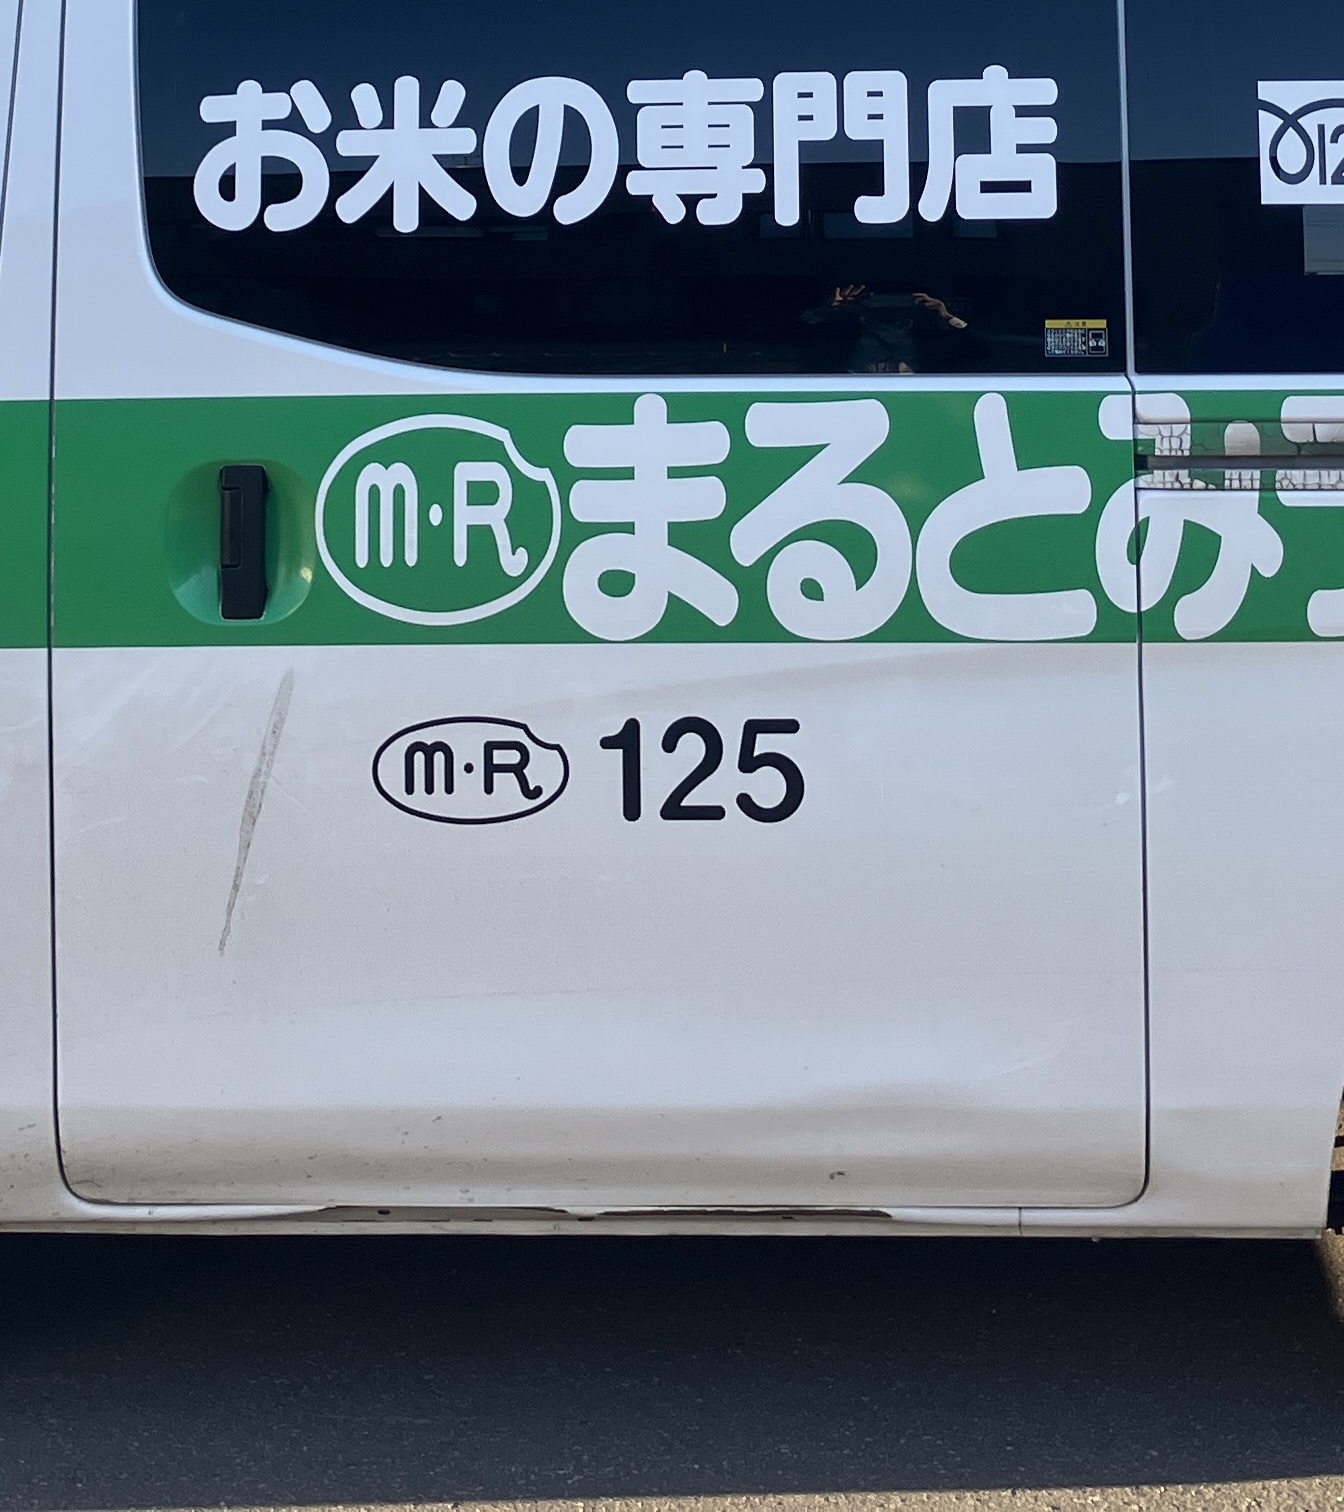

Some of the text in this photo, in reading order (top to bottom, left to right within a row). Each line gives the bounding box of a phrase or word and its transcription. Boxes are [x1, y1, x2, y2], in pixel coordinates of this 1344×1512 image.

[193, 64, 1059, 233] お米の専門店
[599, 716, 805, 824] 125
